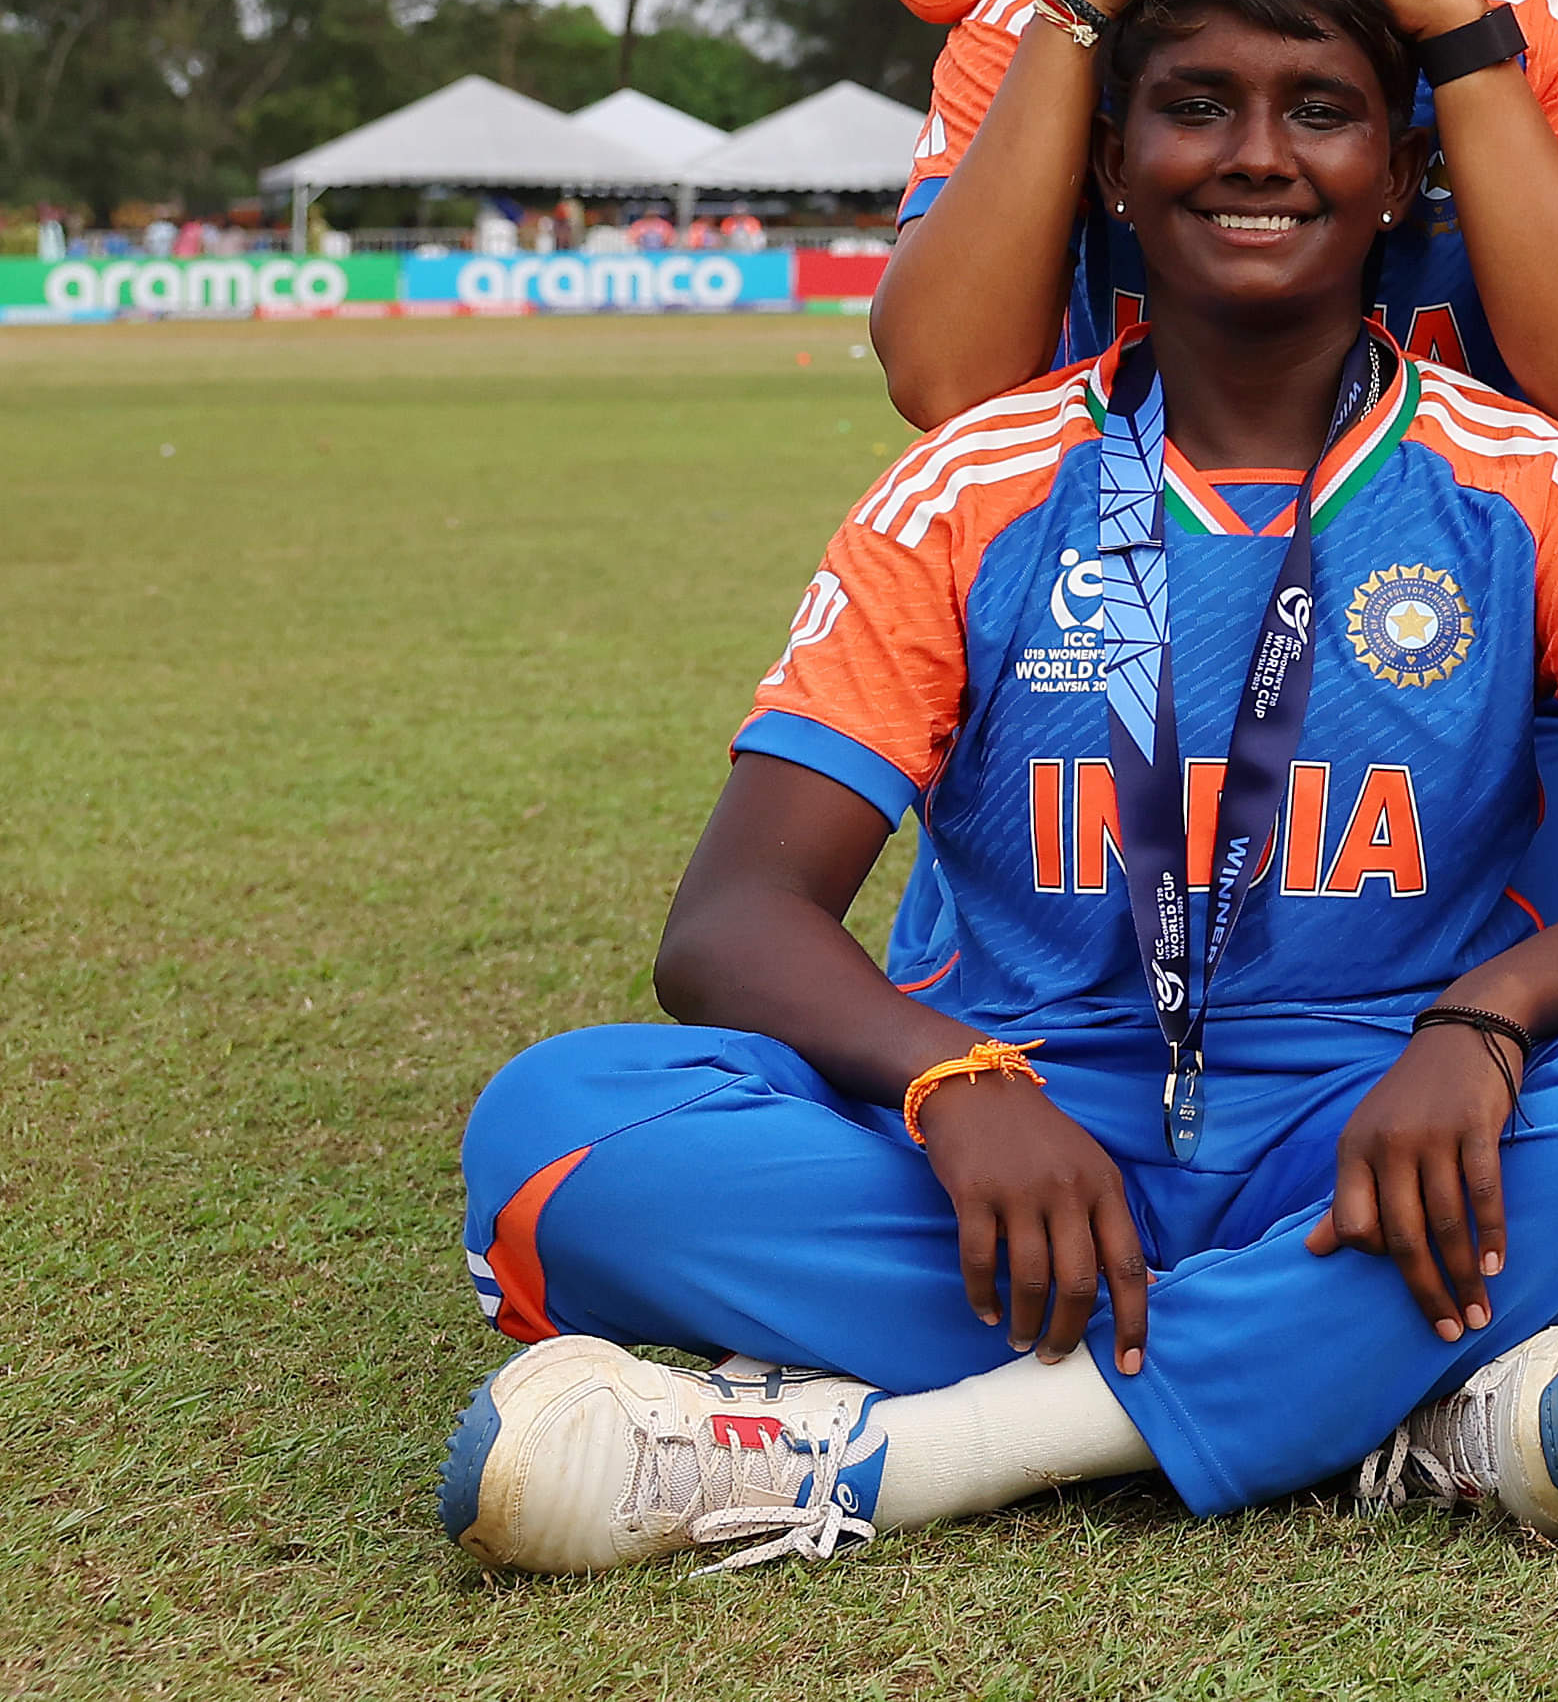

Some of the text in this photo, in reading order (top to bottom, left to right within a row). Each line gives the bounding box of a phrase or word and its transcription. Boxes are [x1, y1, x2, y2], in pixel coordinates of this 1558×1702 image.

[44, 259, 348, 309] aramco
[456, 256, 742, 308] aramco
[1407, 586, 1425, 595] FOR
[1024, 648, 1046, 660] U19
[1063, 631, 1097, 648] ICC
[1290, 639, 1302, 661] ICC
[1015, 661, 1094, 680] WORLD
[1250, 631, 1274, 692] MALAYSIA 2025
[1254, 634, 1286, 720] WORLD CUP
[1273, 652, 1290, 692] WOMEN'S
[1030, 681, 1090, 693] MALAYSIA
[1162, 871, 1180, 959] WORLD CUP
[1207, 836, 1251, 964] WINNER
[1158, 904, 1170, 945] WOMEN'S
[1155, 938, 1165, 960] ICC
